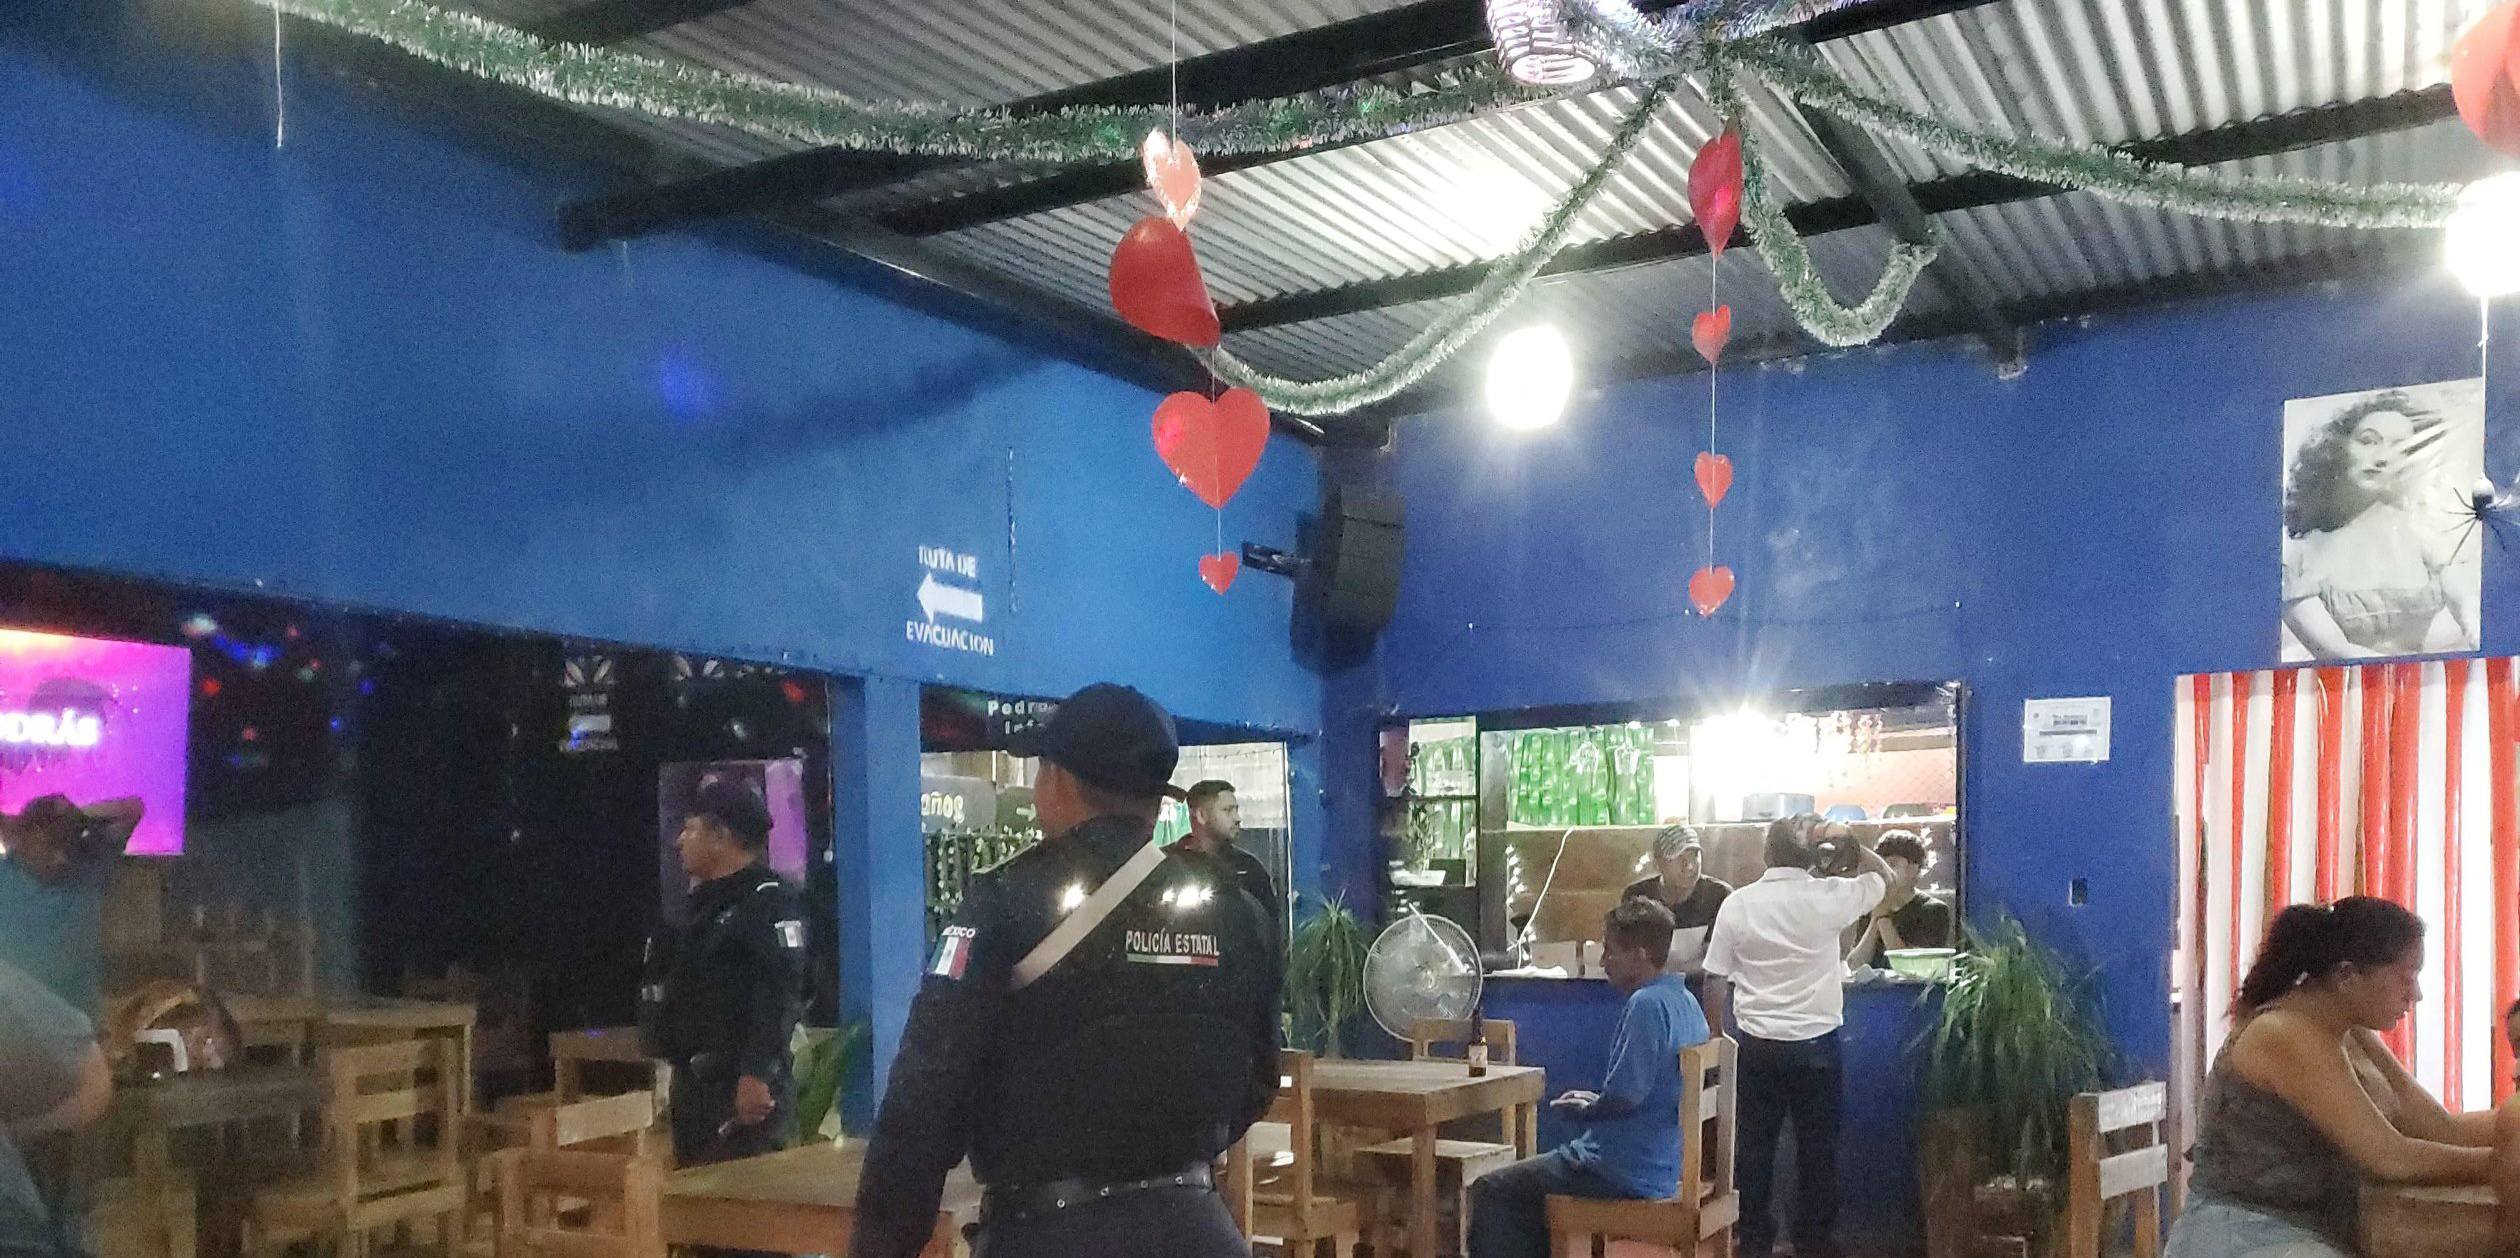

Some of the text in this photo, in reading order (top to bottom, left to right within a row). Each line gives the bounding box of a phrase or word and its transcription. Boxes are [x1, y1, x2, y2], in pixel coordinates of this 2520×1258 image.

[920, 791, 965, 824] años
[1125, 927, 1221, 957] POLICÍA ESTATAL
